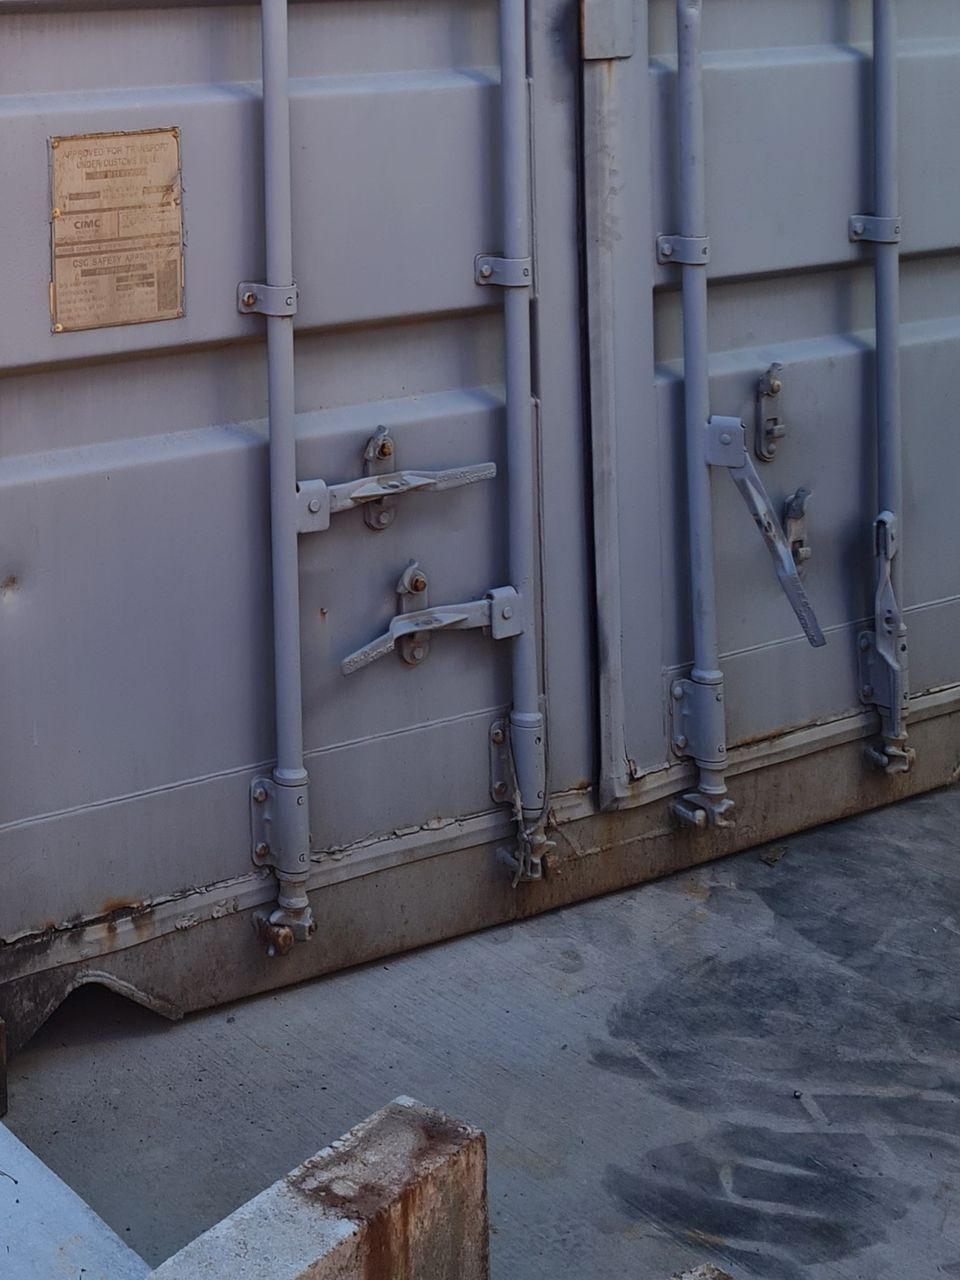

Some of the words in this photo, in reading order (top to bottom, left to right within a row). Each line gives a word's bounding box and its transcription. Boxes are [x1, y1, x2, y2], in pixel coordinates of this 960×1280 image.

[62, 147, 104, 159] APPROVED
[107, 145, 122, 155] FOR
[73, 219, 101, 230] CIMC
[72, 258, 89, 268] CSC
[92, 255, 122, 266] SAFETY
